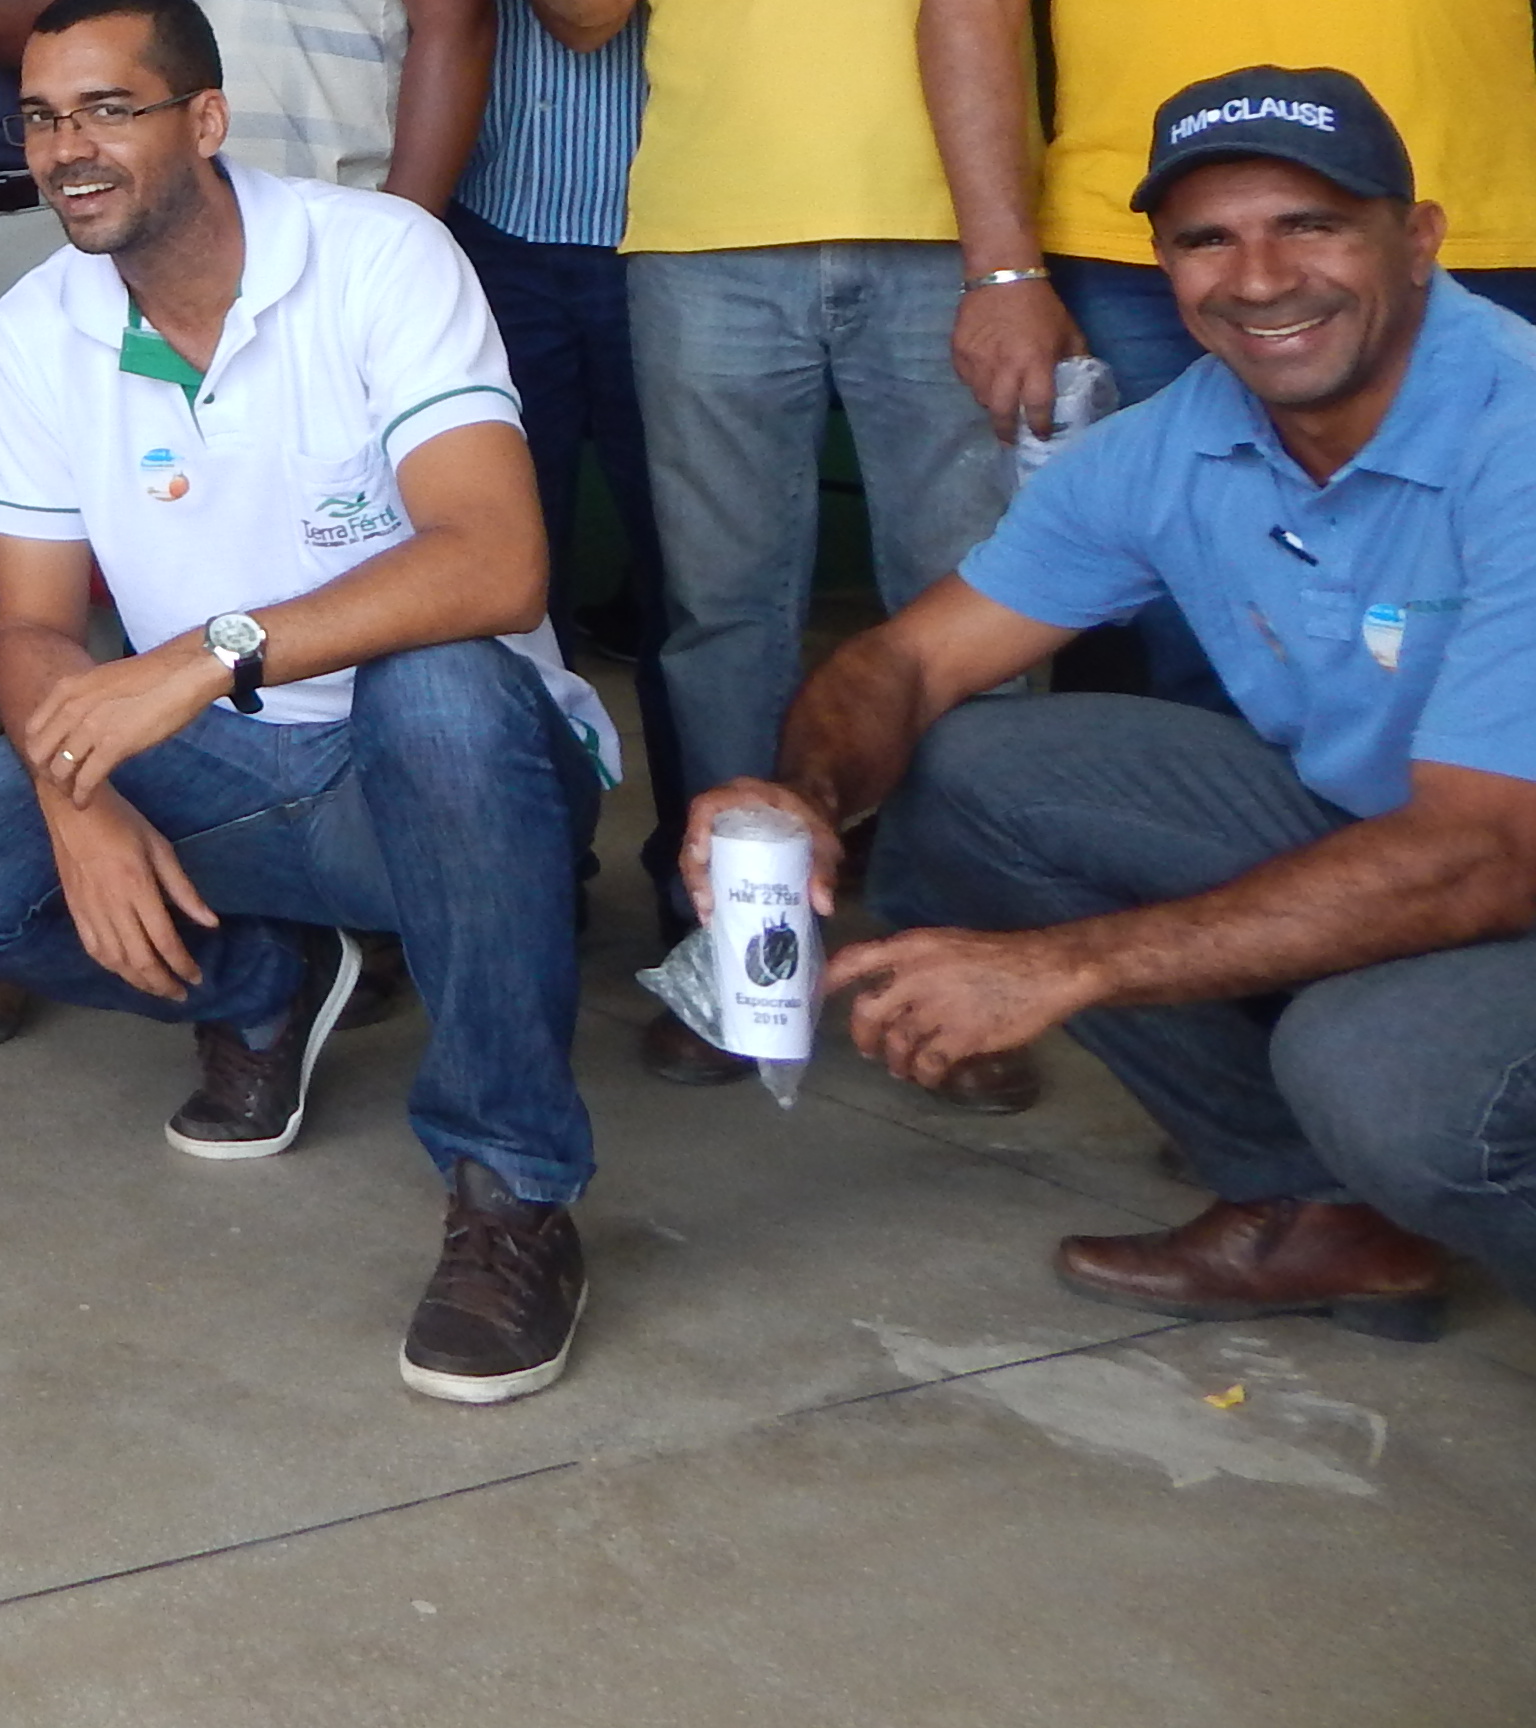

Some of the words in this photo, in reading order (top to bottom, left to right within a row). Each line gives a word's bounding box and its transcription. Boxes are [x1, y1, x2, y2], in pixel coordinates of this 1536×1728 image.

[301, 518, 349, 541] Terra
[728, 886, 757, 905] HM
[762, 888, 801, 907] 2798
[735, 991, 802, 1010] Expocrato
[753, 1010, 789, 1026] 2019
